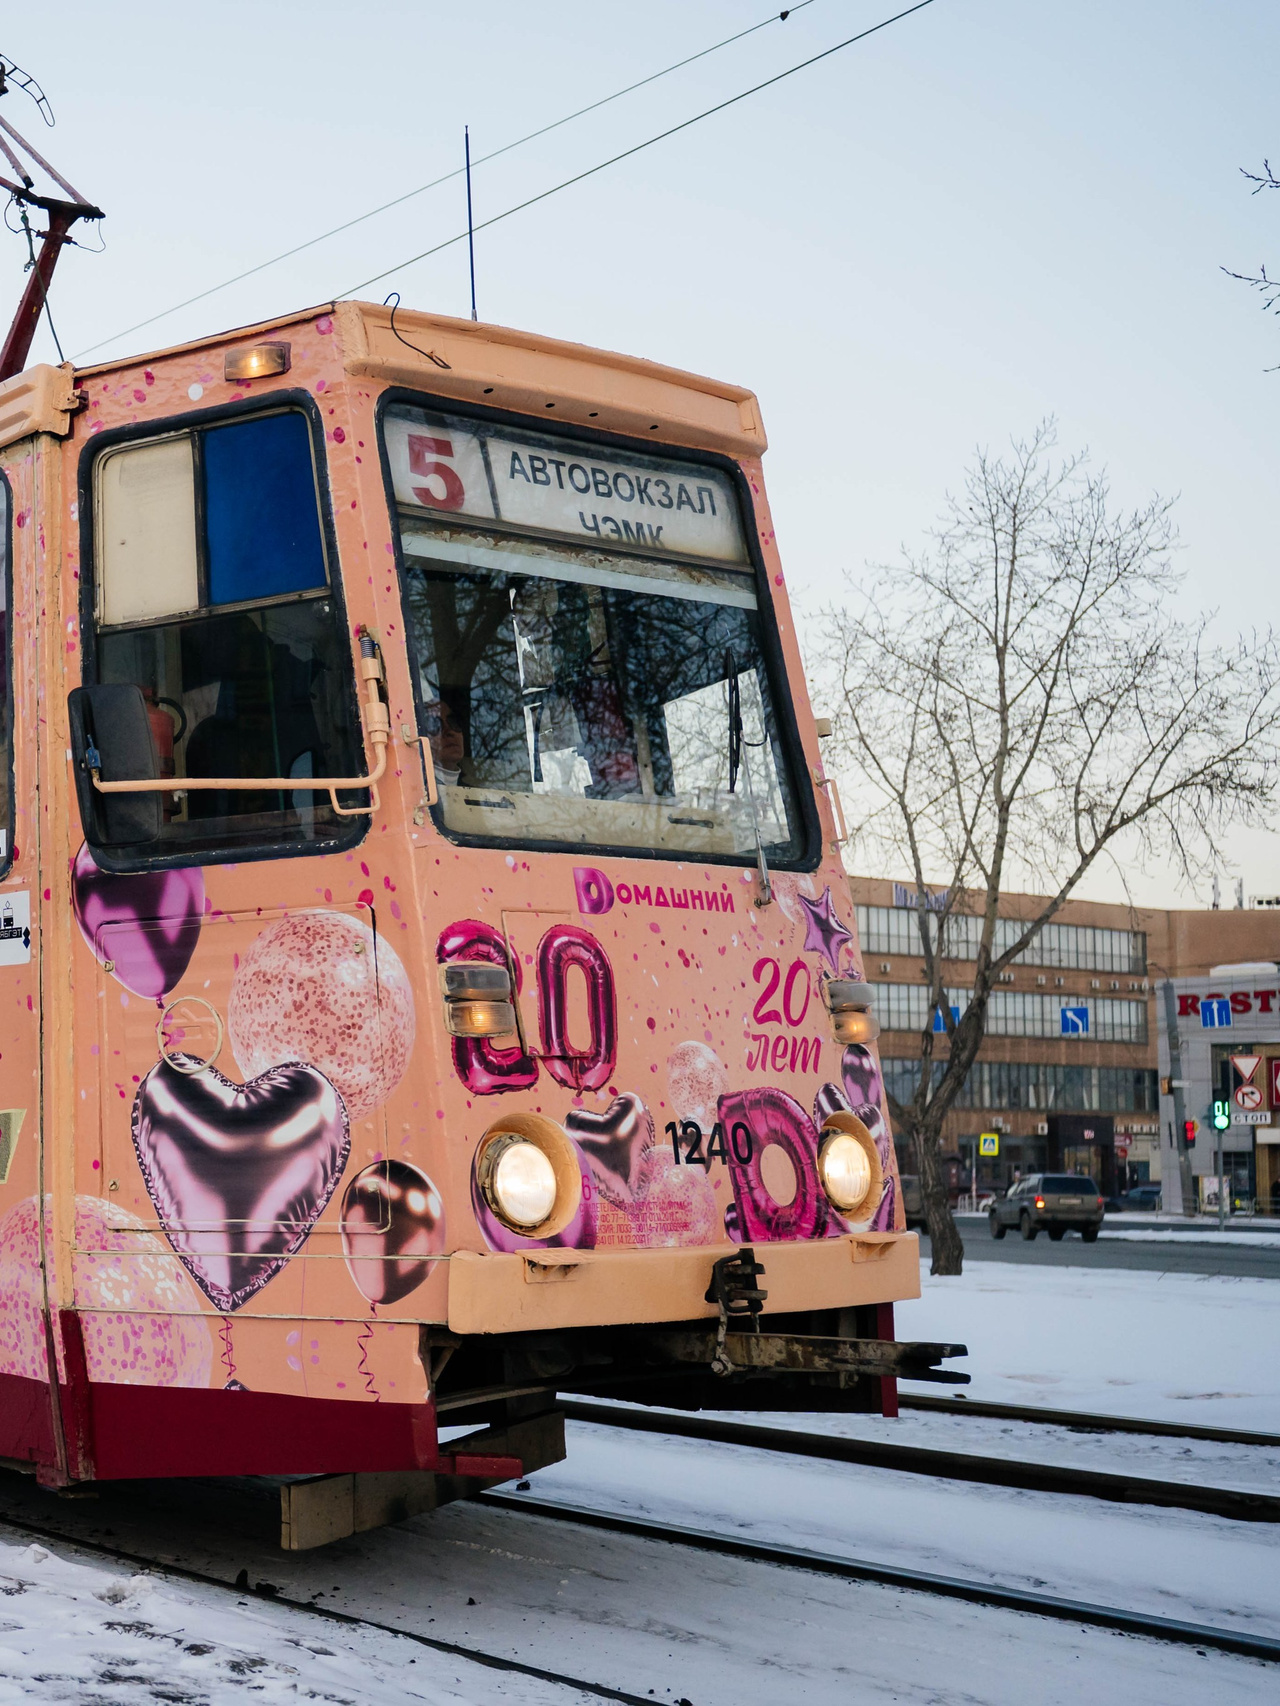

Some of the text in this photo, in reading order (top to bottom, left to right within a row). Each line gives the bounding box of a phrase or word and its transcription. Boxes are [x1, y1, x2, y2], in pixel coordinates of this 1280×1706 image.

[408, 434, 464, 512] 5
[509, 450, 718, 517] АВТОВОКЗАЛ
[752, 956, 811, 1028] 20
[1177, 990, 1280, 1016] RST
[746, 1031, 821, 1076] лет
[1214, 1101, 1229, 1117] 01
[665, 1121, 753, 1165] 1240
[582, 1174, 598, 1201] 6+
